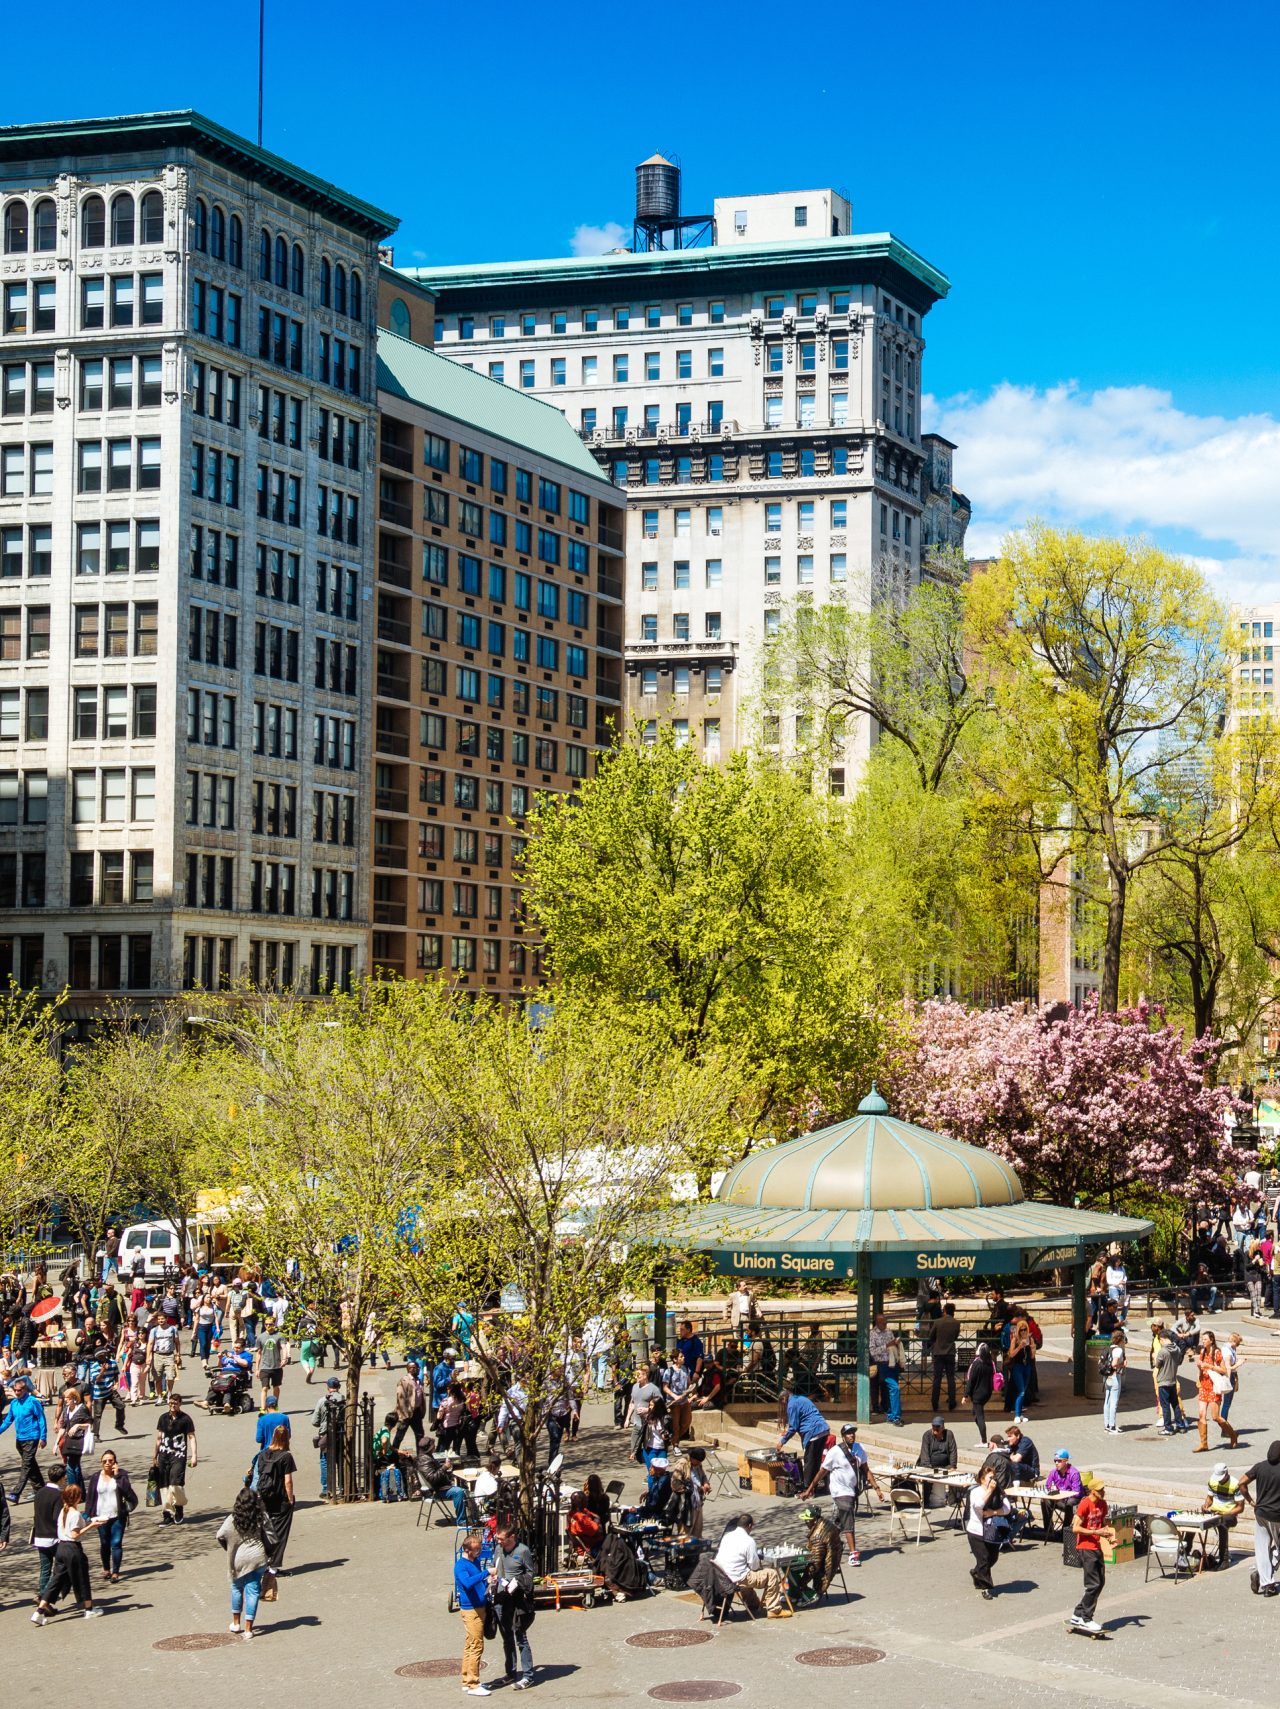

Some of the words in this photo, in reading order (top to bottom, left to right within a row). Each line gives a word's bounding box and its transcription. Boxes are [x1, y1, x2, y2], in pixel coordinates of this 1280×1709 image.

[733, 1252, 776, 1269] Union
[781, 1253, 835, 1273] Square
[916, 1253, 977, 1271] Subway
[1056, 1247, 1077, 1261] Square
